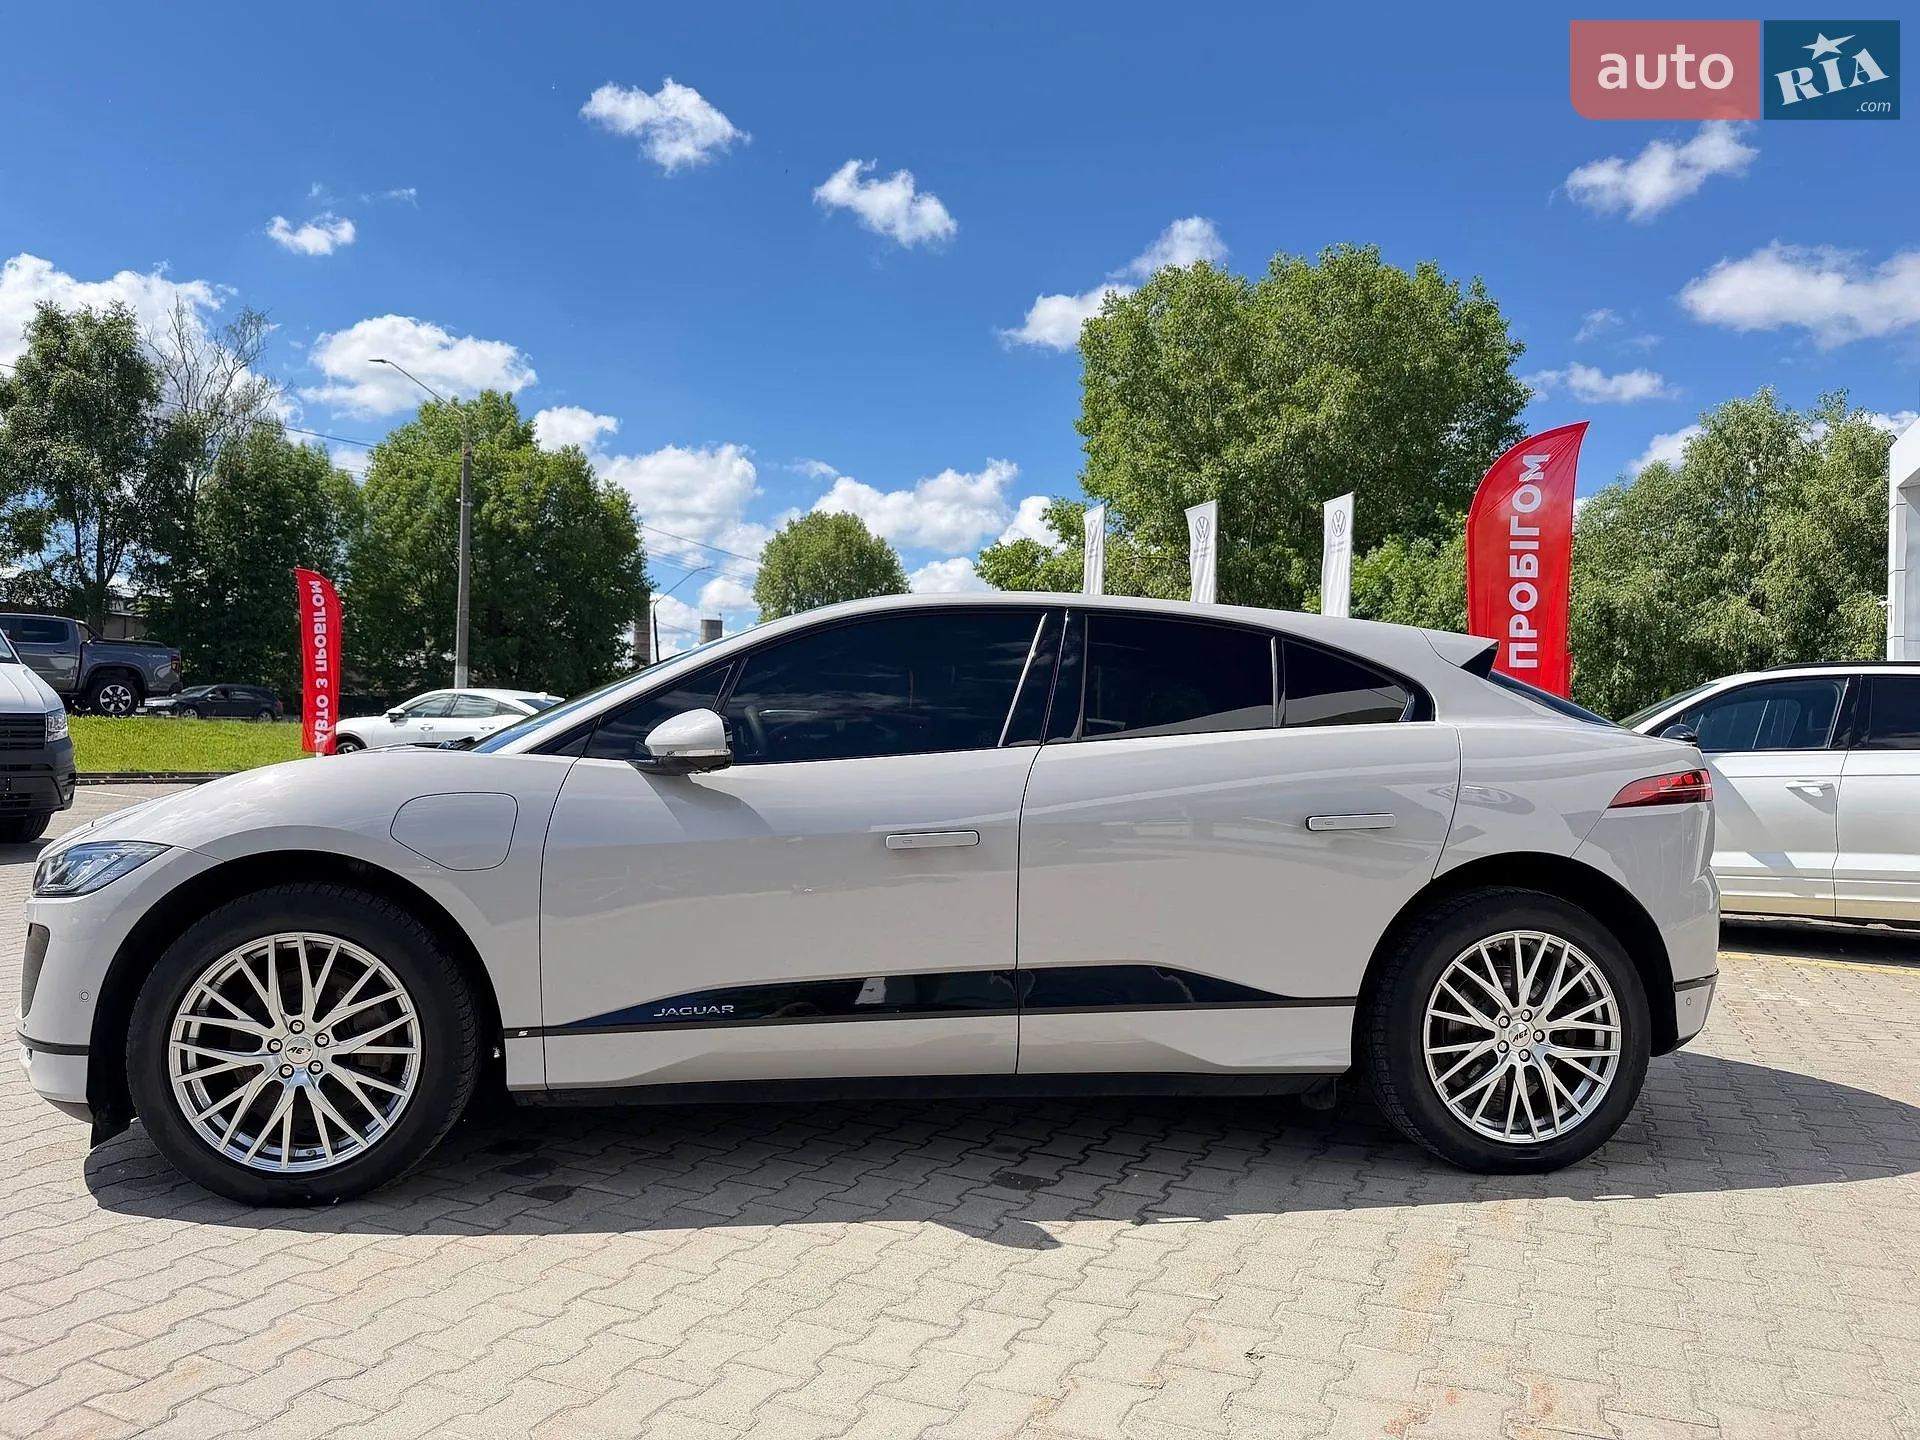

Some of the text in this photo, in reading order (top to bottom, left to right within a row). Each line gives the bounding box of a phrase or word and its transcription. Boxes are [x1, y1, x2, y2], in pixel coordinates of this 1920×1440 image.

[1508, 454, 1549, 668] ПРОБІГОМ
[653, 1005, 735, 1017] JAGUAR
[1512, 1028, 1528, 1043] AEZ
